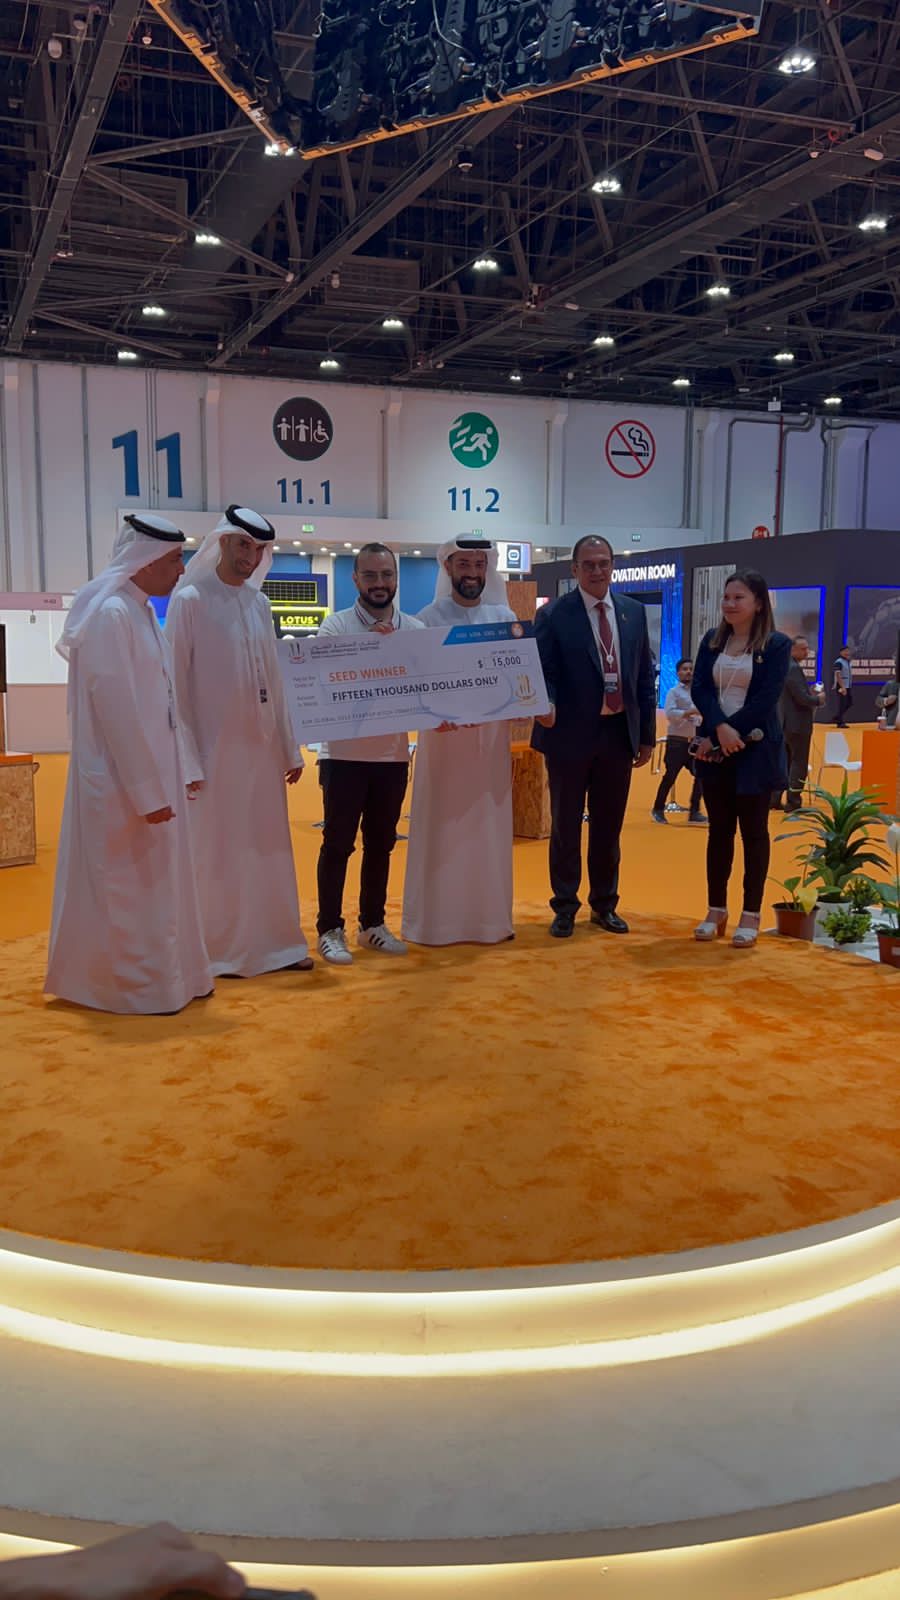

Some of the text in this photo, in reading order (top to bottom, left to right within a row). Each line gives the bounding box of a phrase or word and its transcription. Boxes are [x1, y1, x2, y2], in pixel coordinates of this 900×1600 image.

[112, 430, 183, 498] 11
[277, 478, 332, 505] 11.1
[448, 486, 500, 512] 11.2
[611, 563, 675, 583] OVATION ROOM
[329, 665, 407, 683] SEED WINNER
[477, 655, 521, 669] $ 15,000
[332, 675, 498, 702] FIFTEEN THOUSAND DOLLARS ONLY
